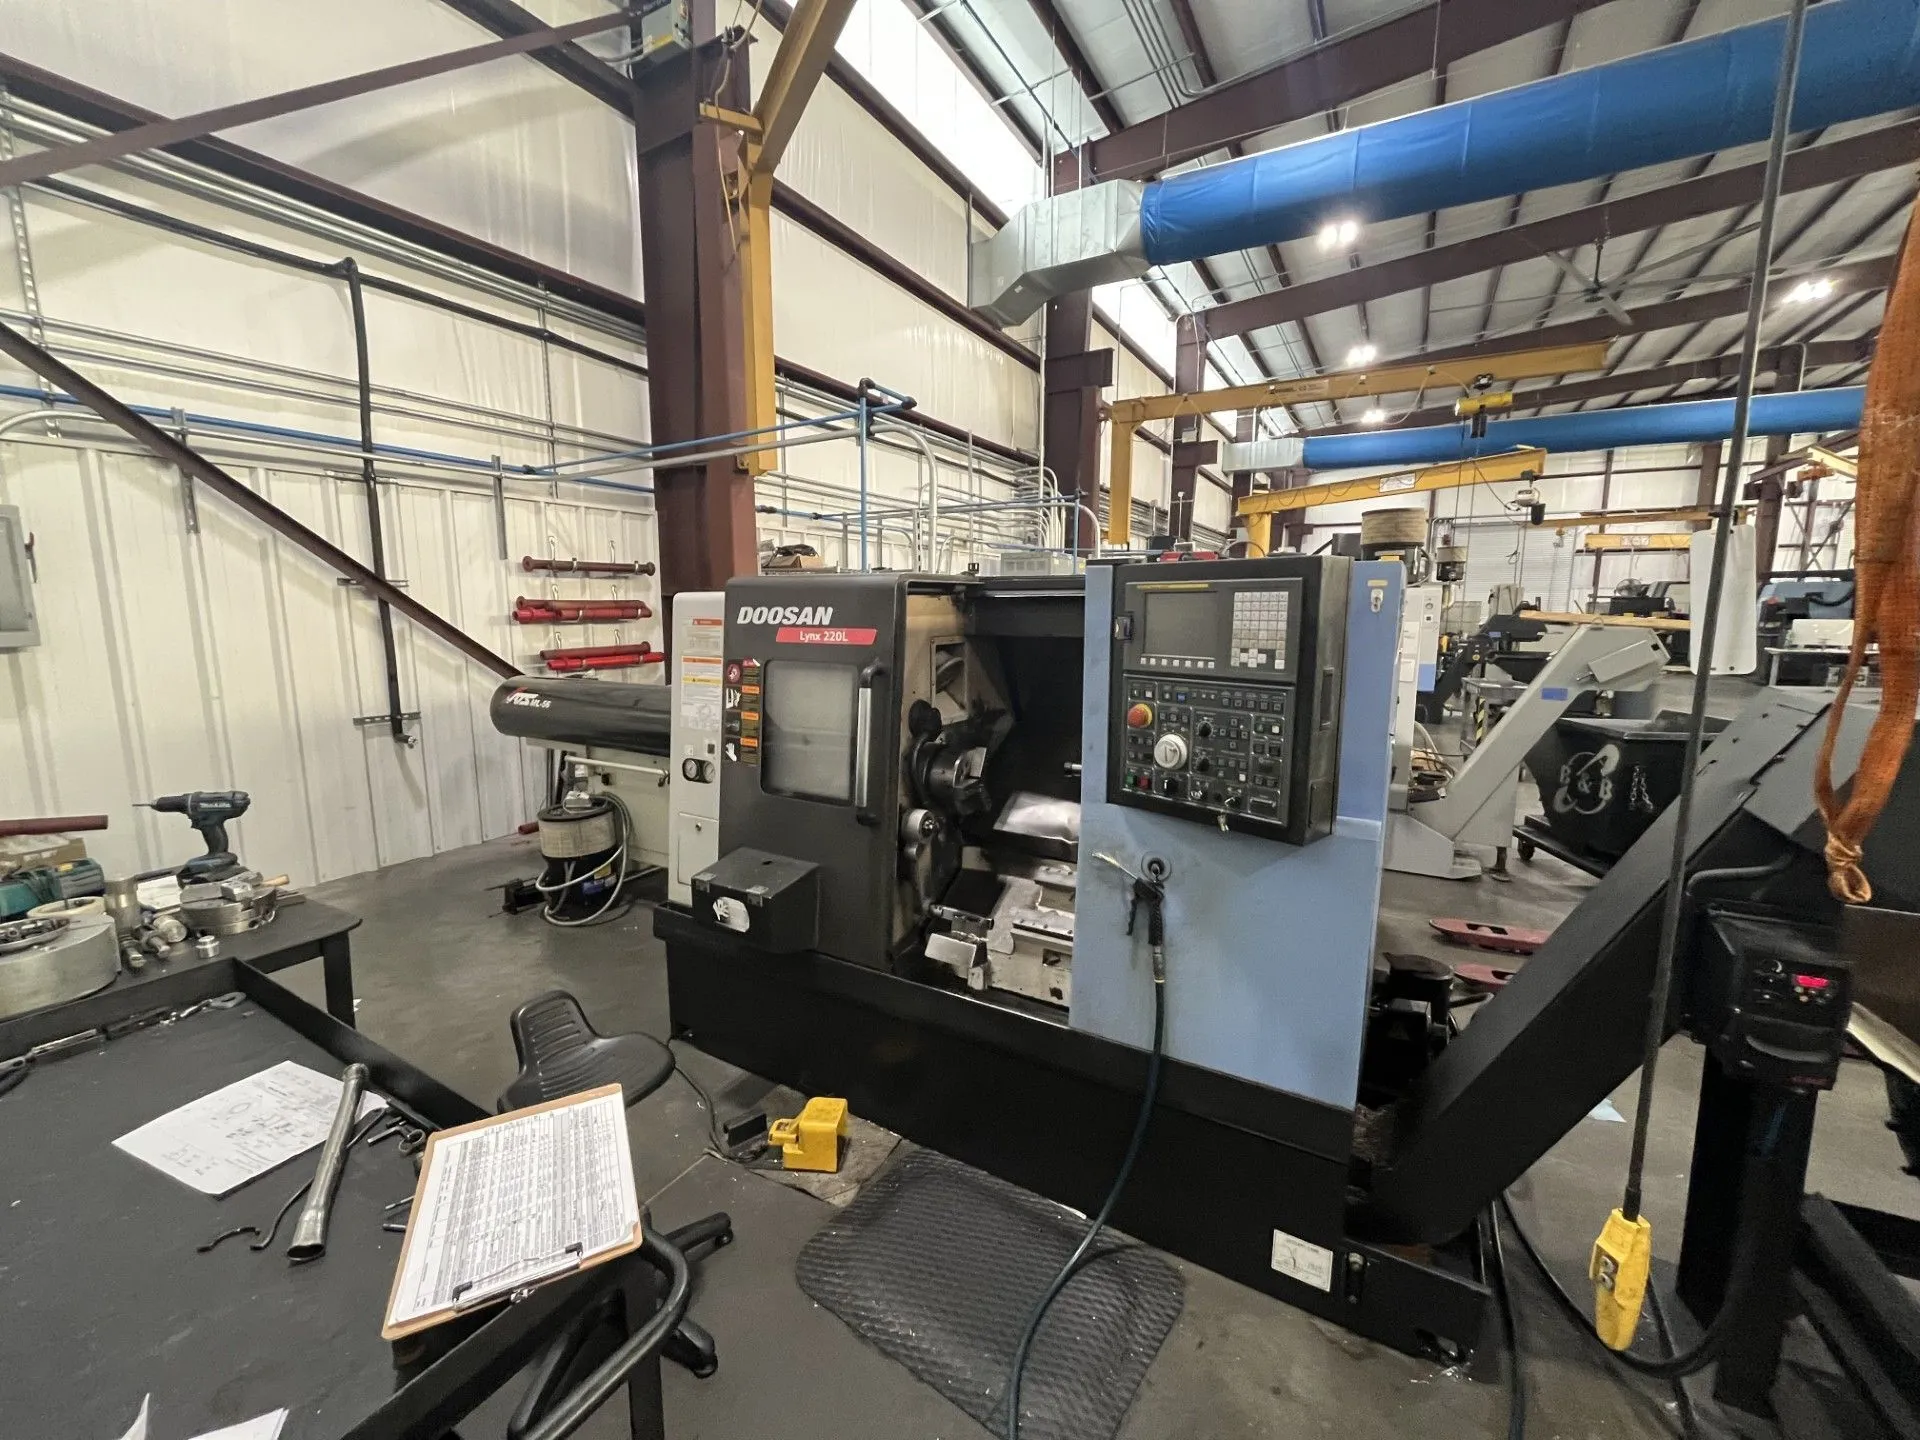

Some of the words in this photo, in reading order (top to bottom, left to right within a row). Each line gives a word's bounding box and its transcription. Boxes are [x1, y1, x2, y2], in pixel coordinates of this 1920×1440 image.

[736, 606, 834, 625] DOOSAN
[799, 630, 821, 642] Lynx
[823, 631, 848, 642] 220L
